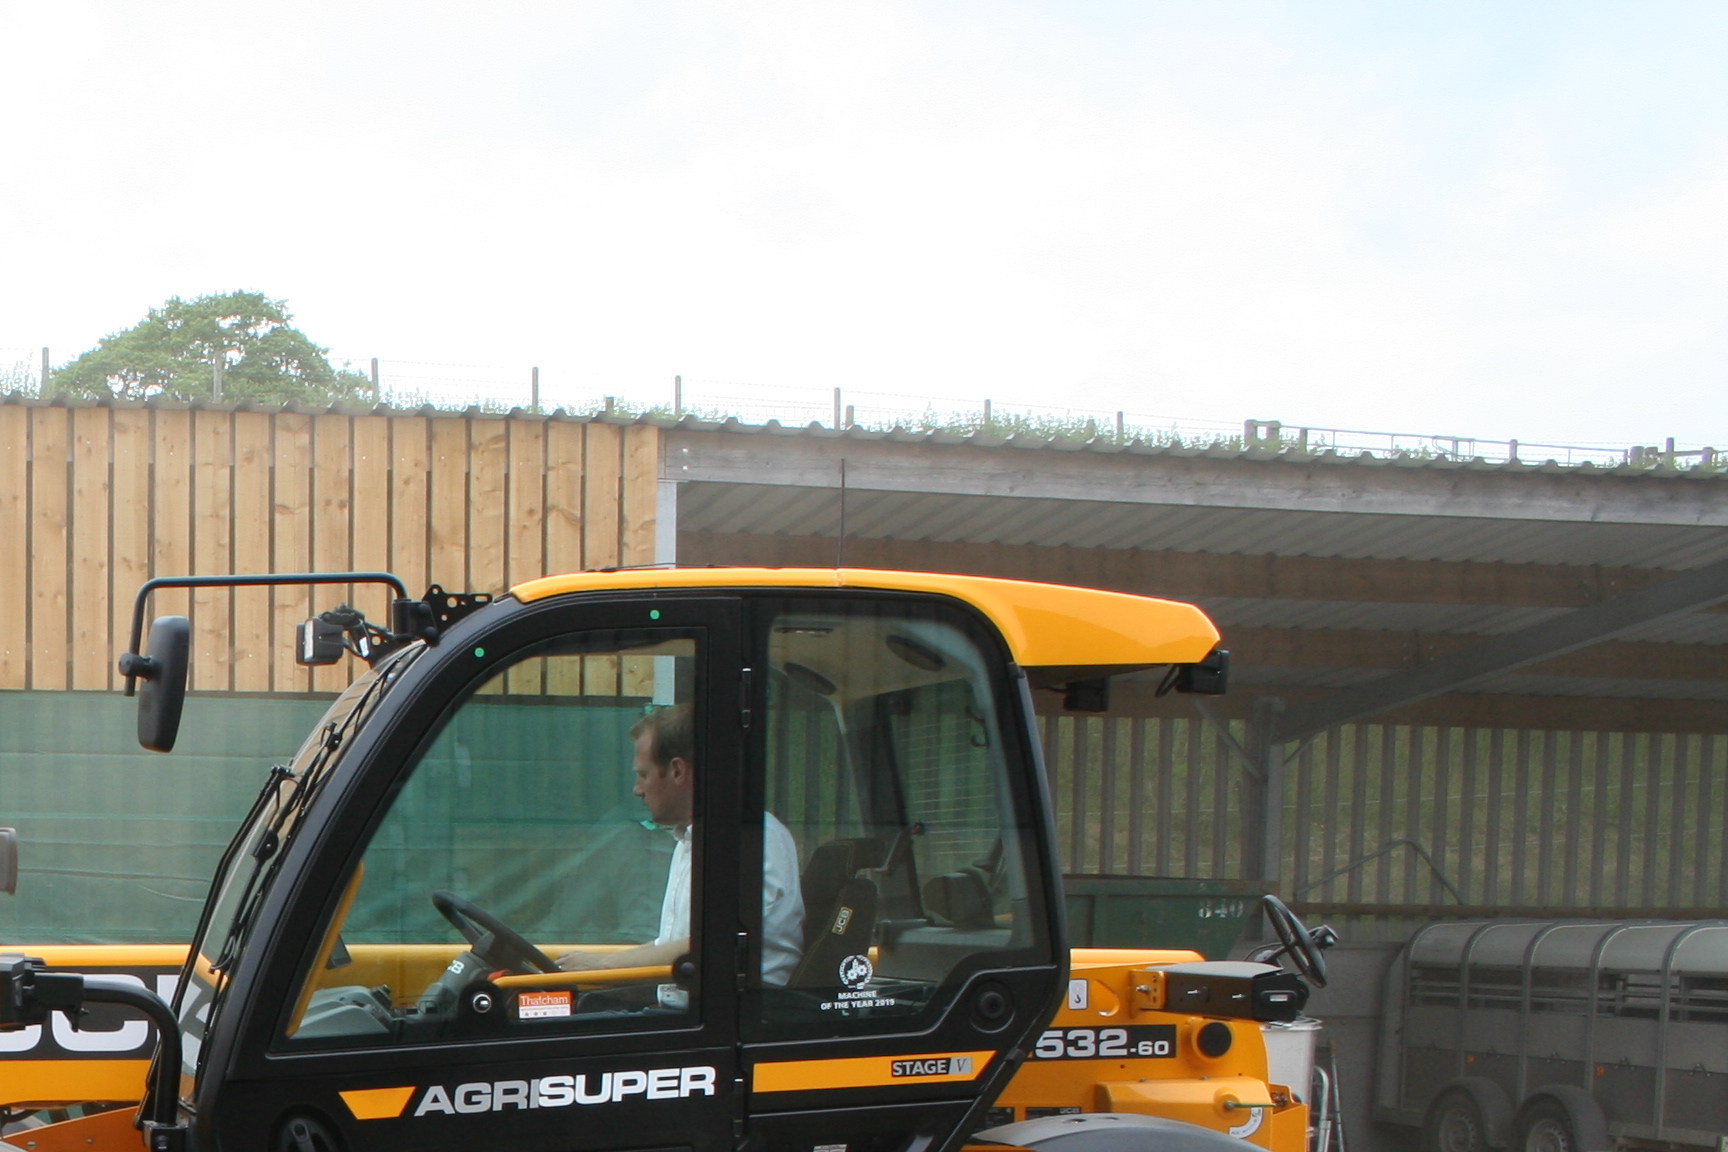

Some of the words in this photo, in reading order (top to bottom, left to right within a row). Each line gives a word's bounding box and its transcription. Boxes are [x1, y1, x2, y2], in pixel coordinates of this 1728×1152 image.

[835, 909, 850, 933] JCB
[521, 995, 569, 1006] Thatcham
[820, 1002, 832, 1011] OF
[833, 1001, 850, 1010] THE
[851, 1000, 874, 1009] YEAR
[875, 998, 896, 1007] 2019
[837, 990, 878, 1000] MACHINE
[1035, 1028, 1170, 1059] 532-60
[892, 1060, 947, 1077] STAGE
[955, 1058, 967, 1073] V
[413, 1065, 717, 1118] AGRISUPER
